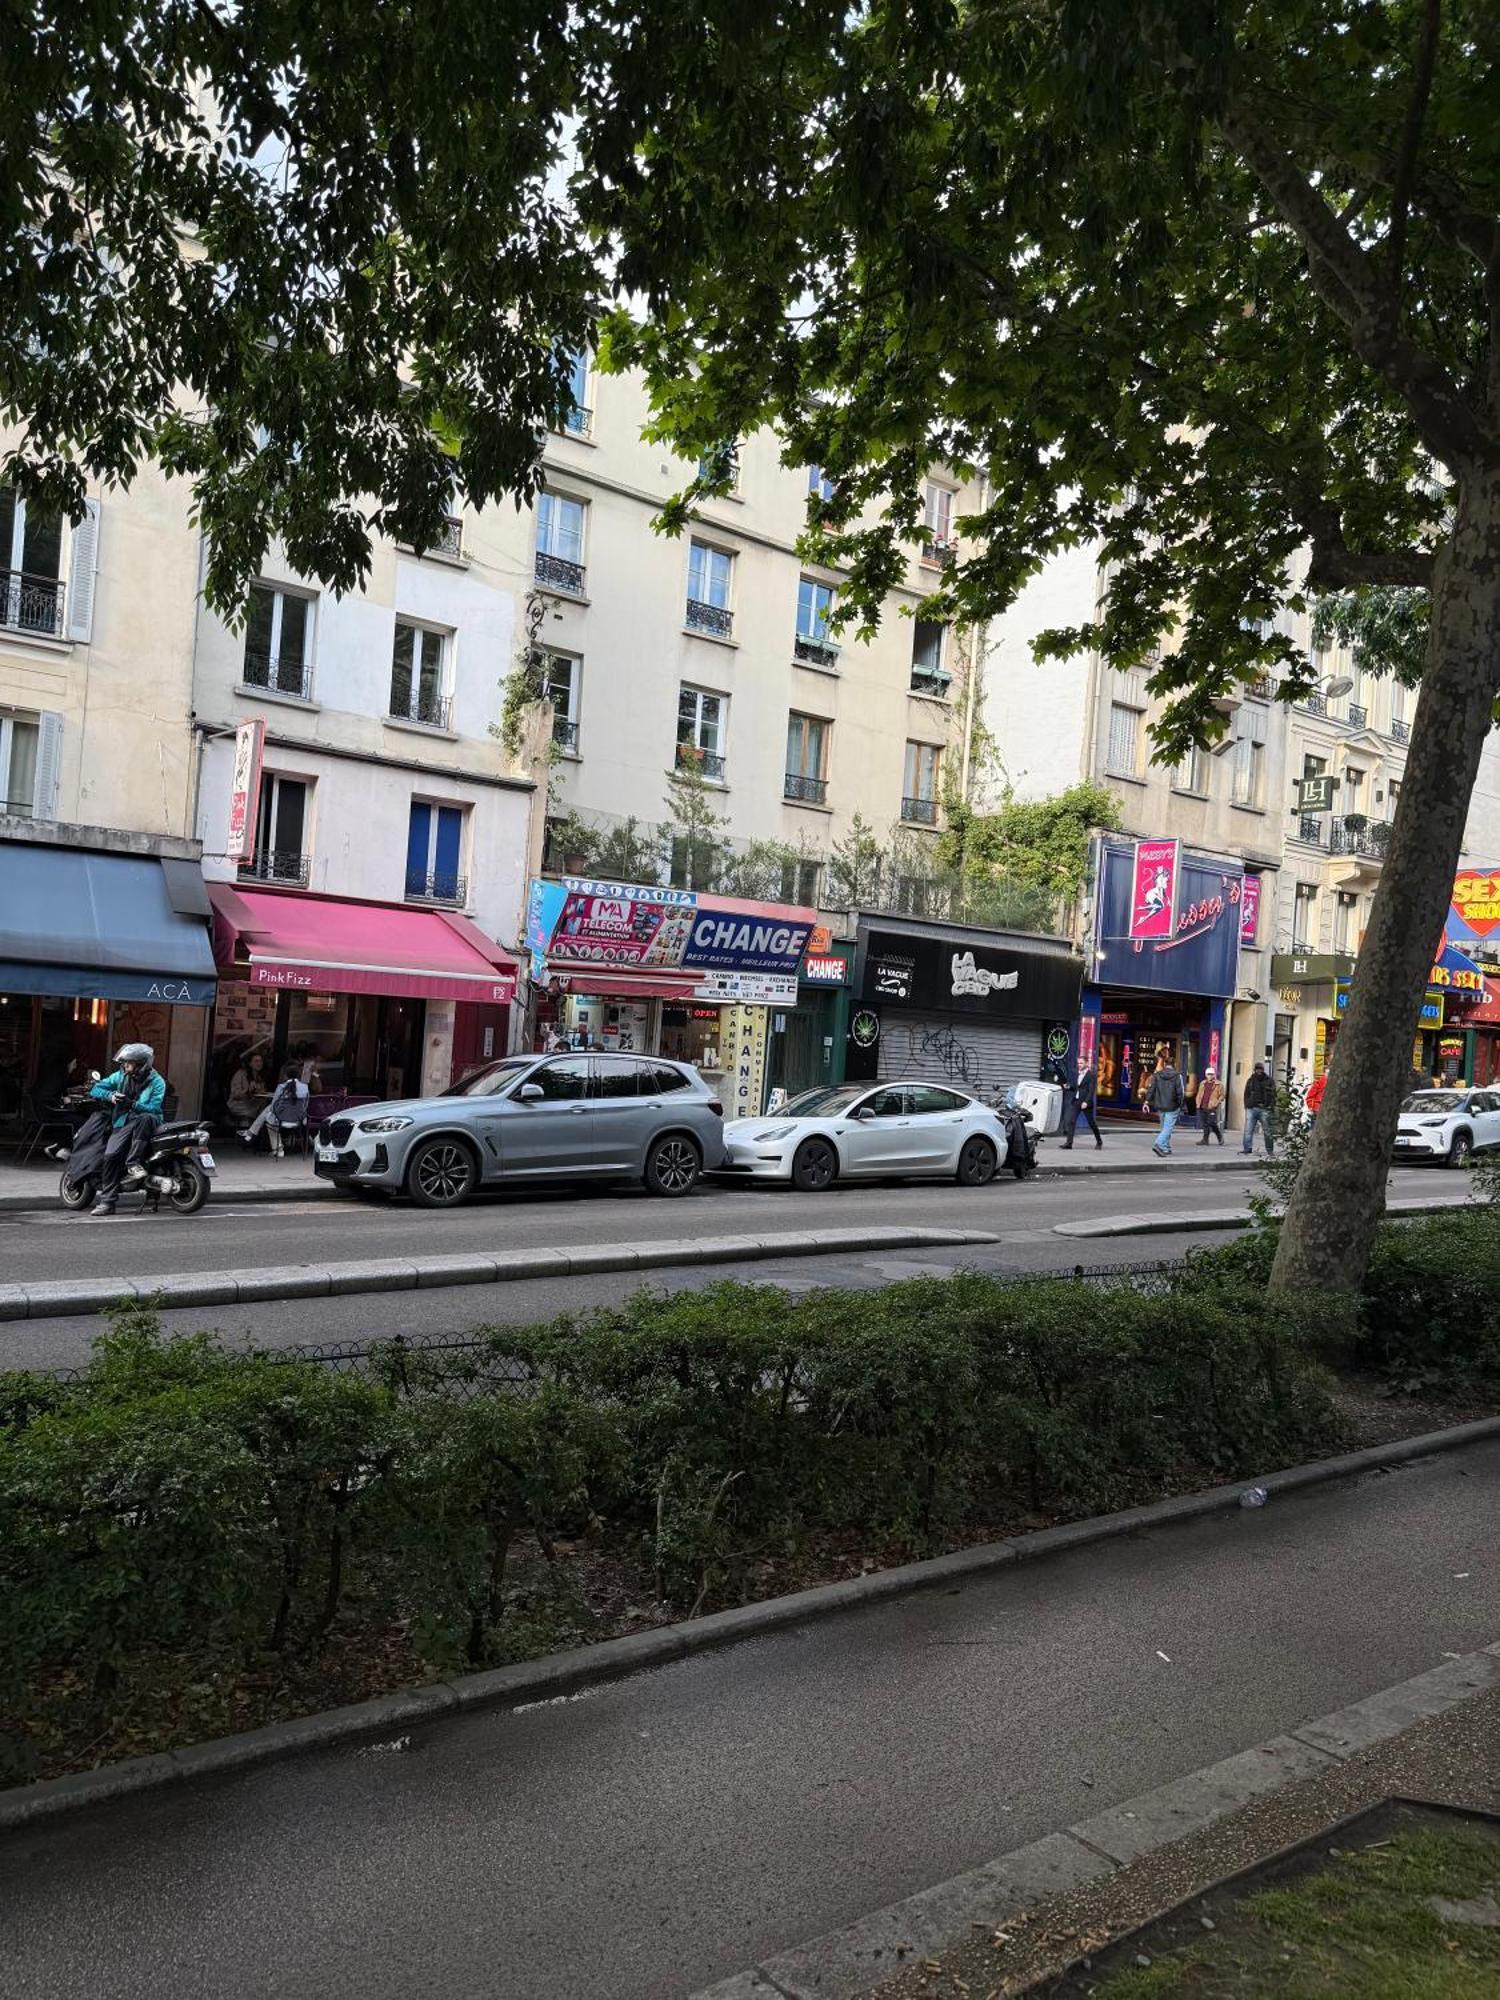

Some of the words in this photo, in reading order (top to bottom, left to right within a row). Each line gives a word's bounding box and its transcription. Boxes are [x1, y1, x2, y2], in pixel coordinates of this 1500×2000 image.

[599, 901, 623, 919] MA
[1463, 903, 1500, 920] SHO
[583, 918, 632, 932] TELECOM
[693, 919, 807, 956] CHANGE
[686, 953, 708, 961] BEST
[952, 952, 975, 968] LA
[259, 969, 285, 983] Pink
[286, 971, 312, 986] Fizz
[807, 959, 845, 980] CHANGE
[878, 968, 886, 976] LA
[887, 969, 909, 980] VAGUE
[951, 966, 1019, 989] VAGUE
[147, 981, 192, 1000] ACÀ
[951, 982, 990, 996] CBD
[738, 1004, 753, 1117] CHANGE
